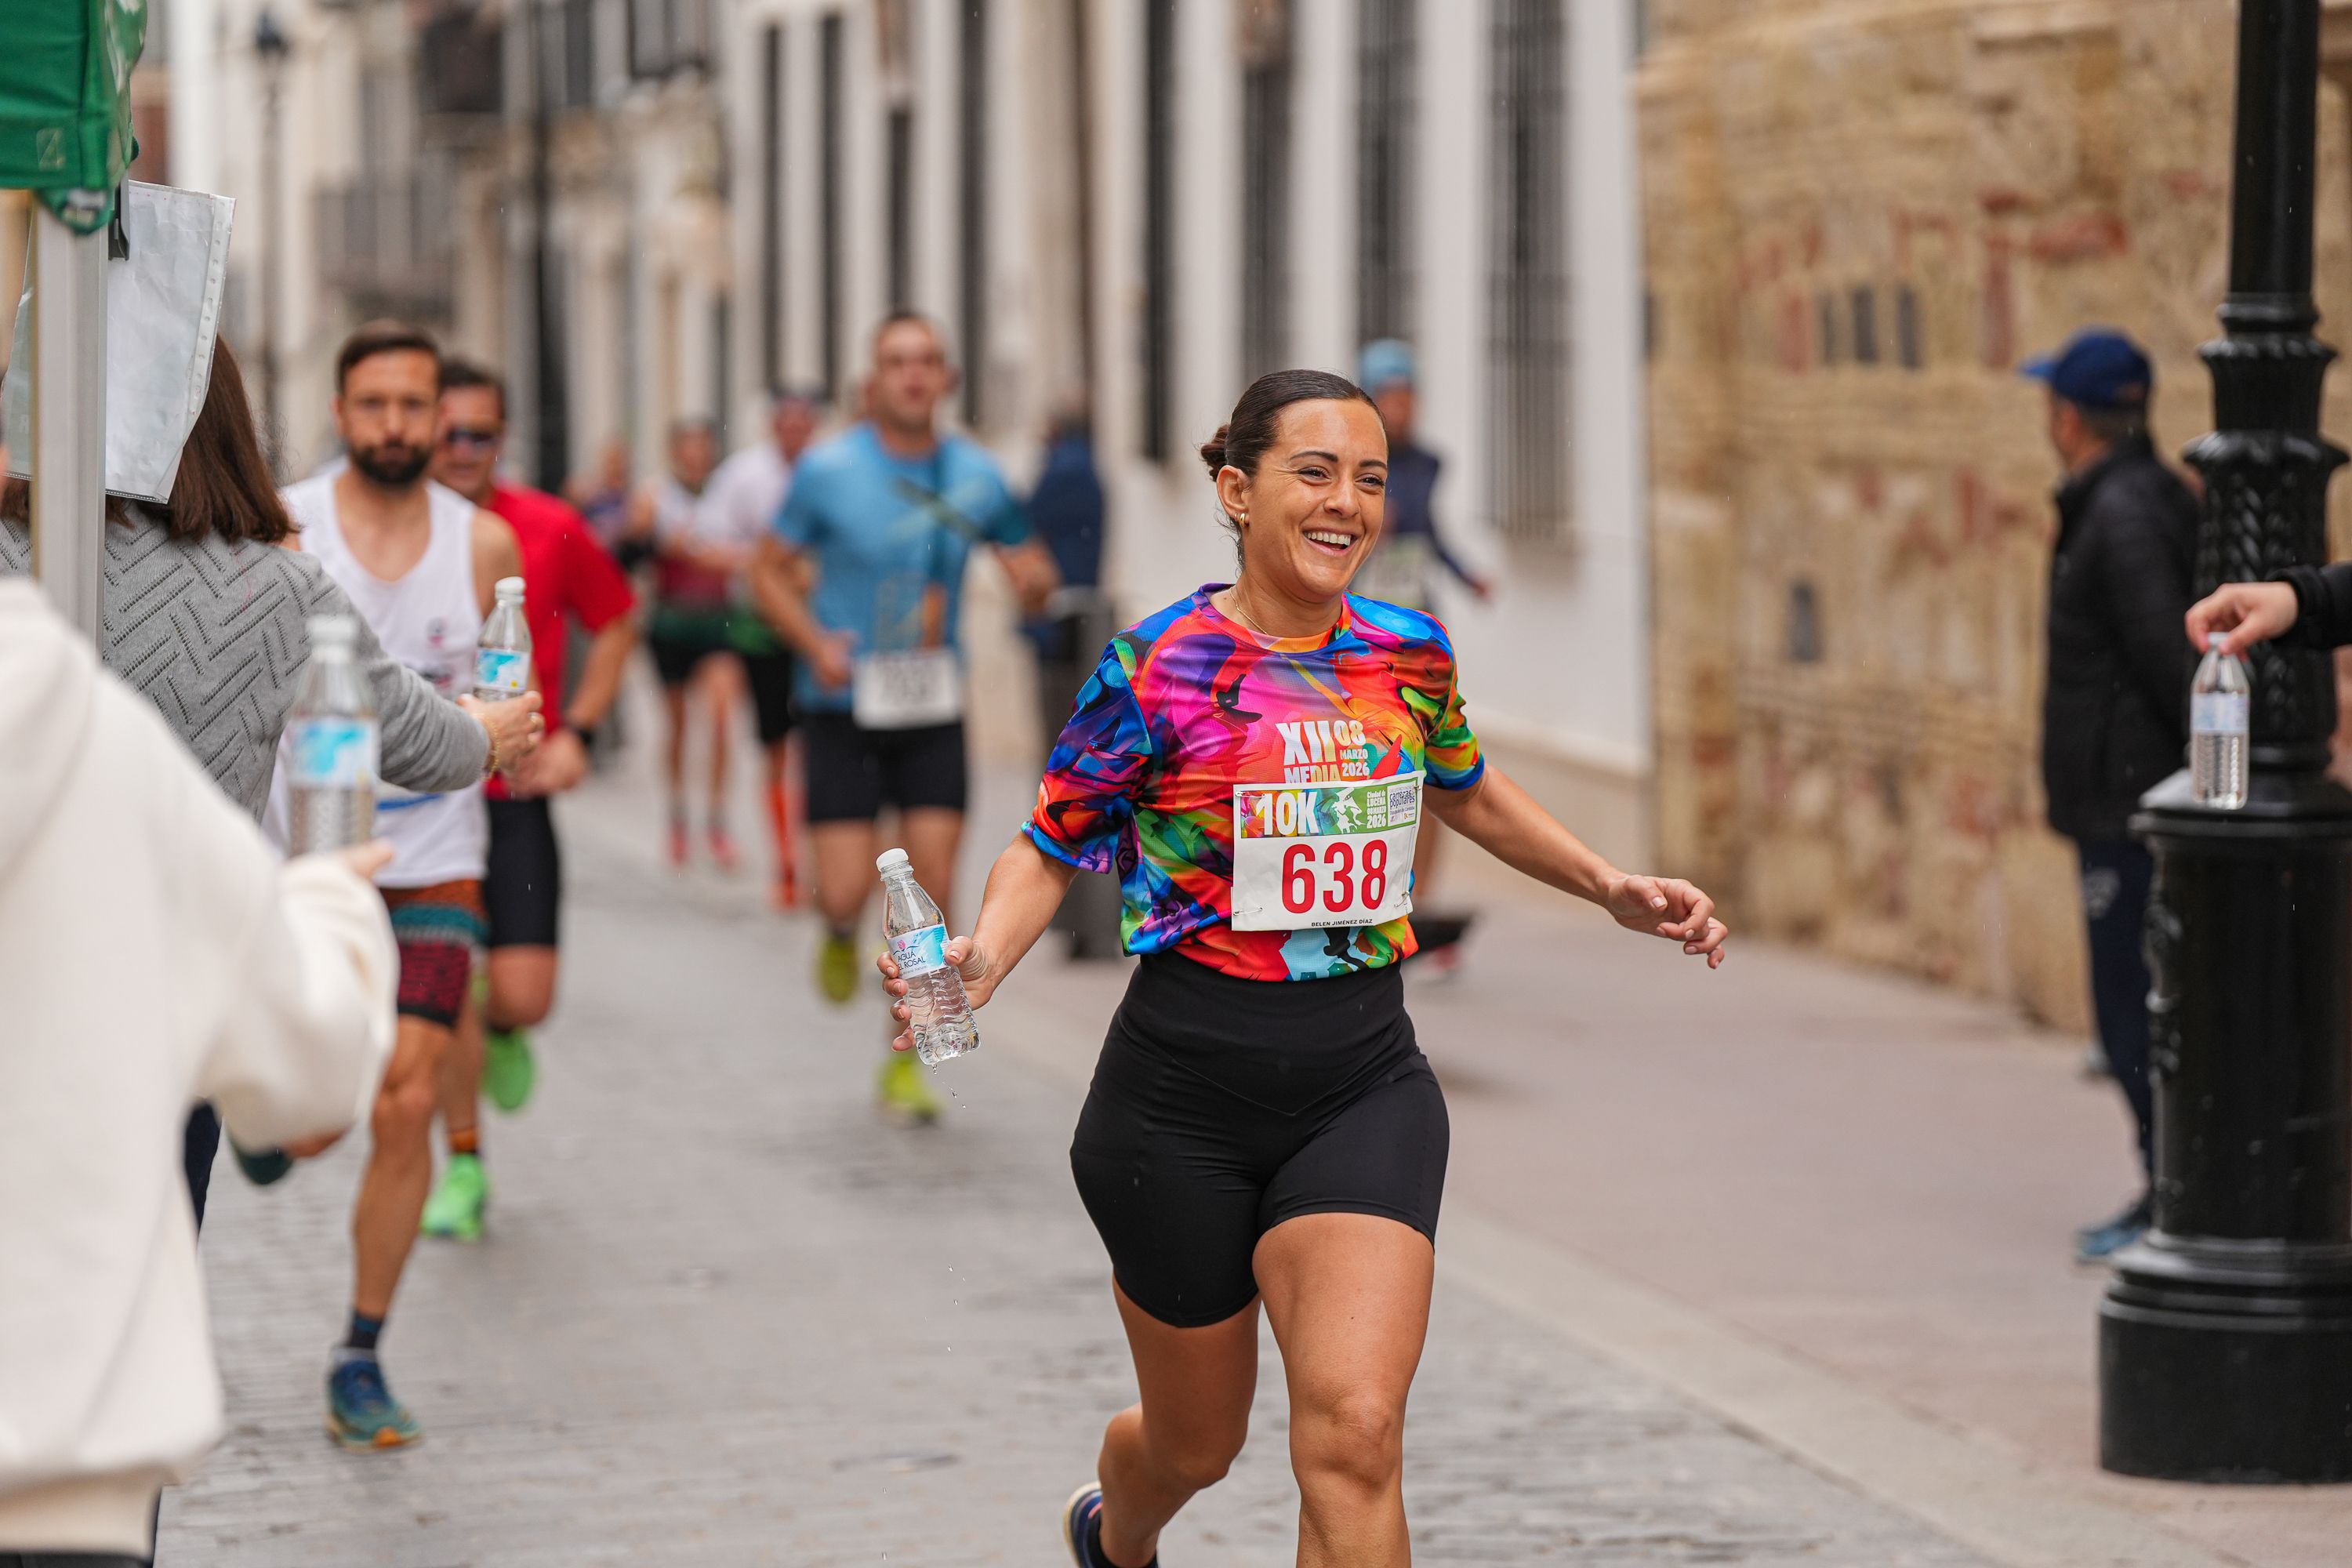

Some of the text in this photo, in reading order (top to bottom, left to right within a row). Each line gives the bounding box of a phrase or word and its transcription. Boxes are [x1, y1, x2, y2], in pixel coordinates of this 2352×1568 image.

[1334, 720, 1367, 746] 08
[1275, 720, 1337, 766] XII
[1339, 748, 1369, 760] MARZO
[1283, 764, 1341, 783] MEDIA
[1341, 761, 1370, 777] 2026
[1367, 797, 1386, 807] LUCENA
[1389, 795, 1415, 808] populares
[1255, 791, 1319, 836] 10K
[1367, 814, 1387, 829] 2026
[1282, 840, 1388, 913] 638
[898, 951, 916, 962] AGUA
[904, 956, 926, 968] ROSAL
